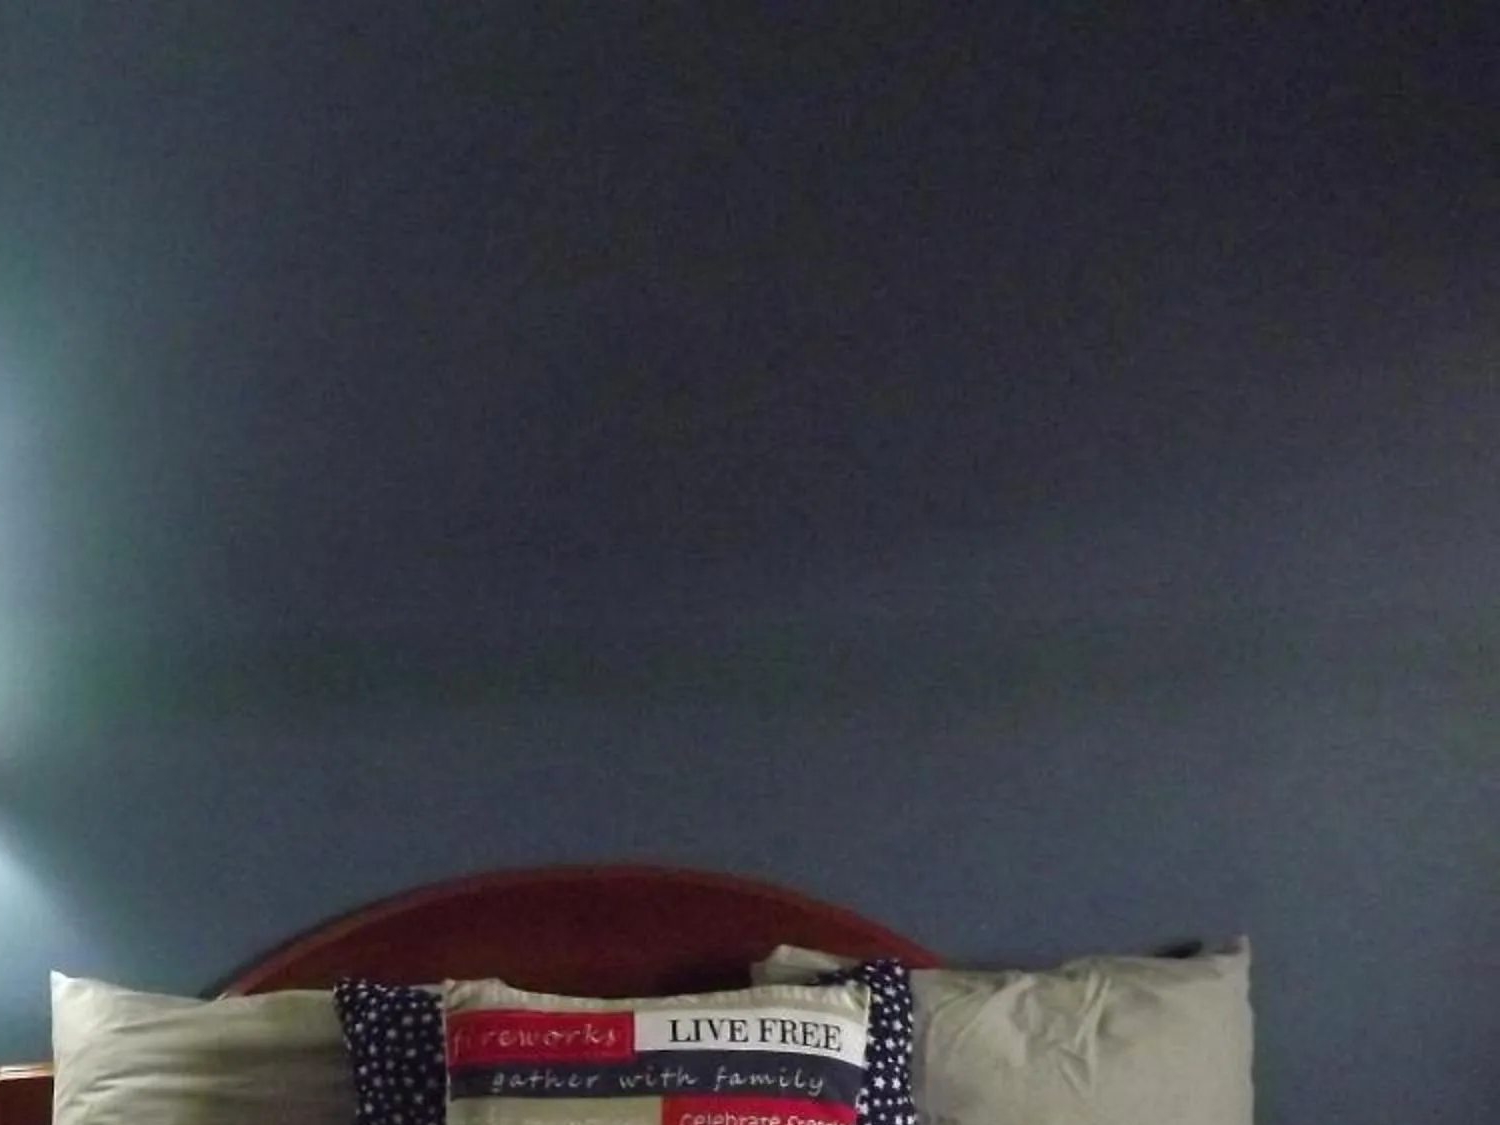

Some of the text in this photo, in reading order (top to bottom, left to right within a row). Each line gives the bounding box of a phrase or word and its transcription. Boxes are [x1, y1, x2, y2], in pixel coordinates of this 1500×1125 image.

[669, 1018, 841, 1051] LIVE FREE
[491, 1066, 826, 1095] gather with family
